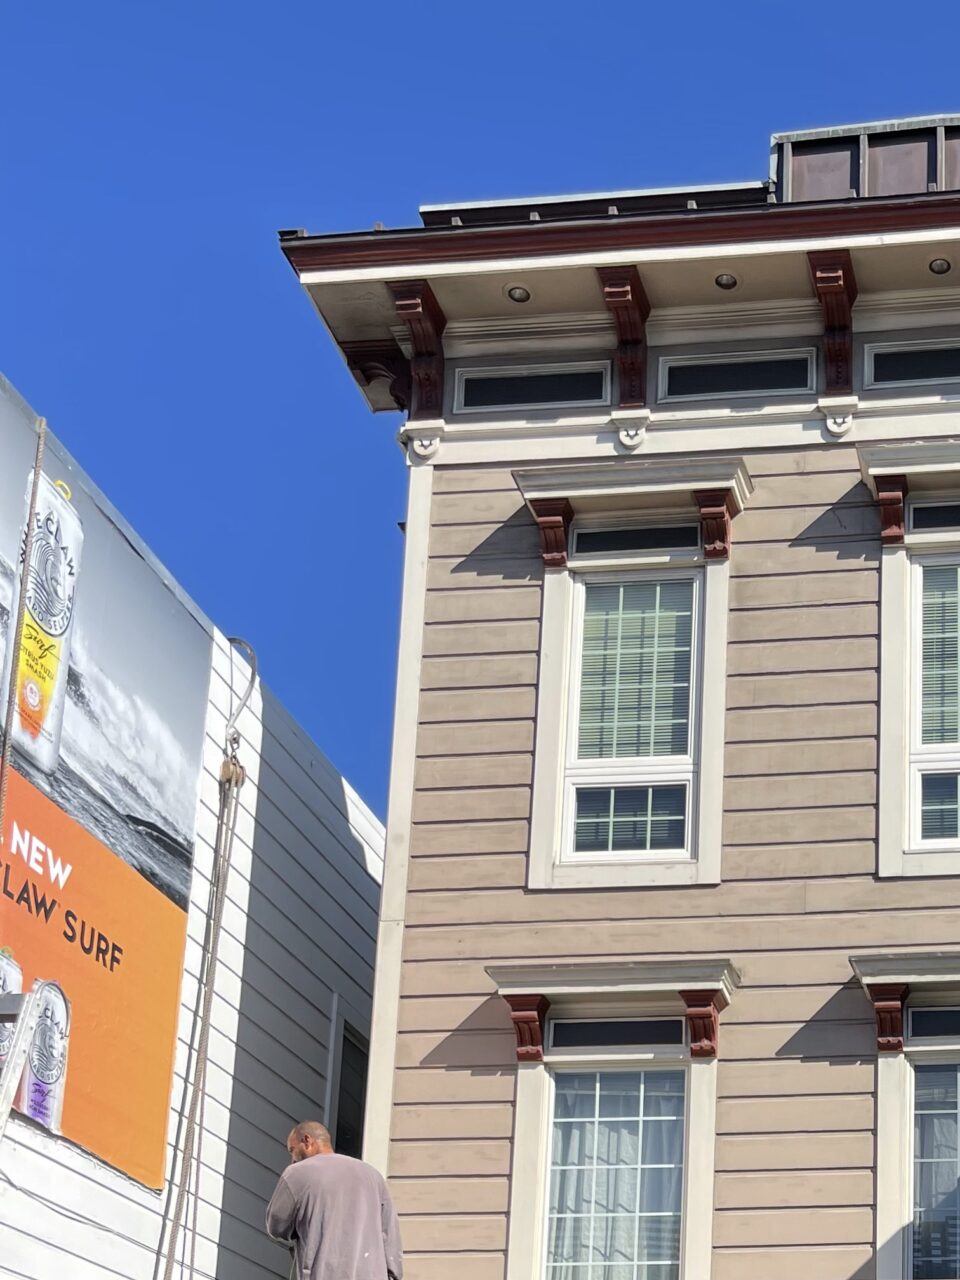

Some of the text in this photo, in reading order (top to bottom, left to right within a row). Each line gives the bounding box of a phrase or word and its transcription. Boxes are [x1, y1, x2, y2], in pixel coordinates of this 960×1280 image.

[46, 516, 75, 577] CLAW
[24, 623, 60, 660] Surf
[10, 820, 73, 891] NEW
[0, 860, 124, 973] LAW SURF
